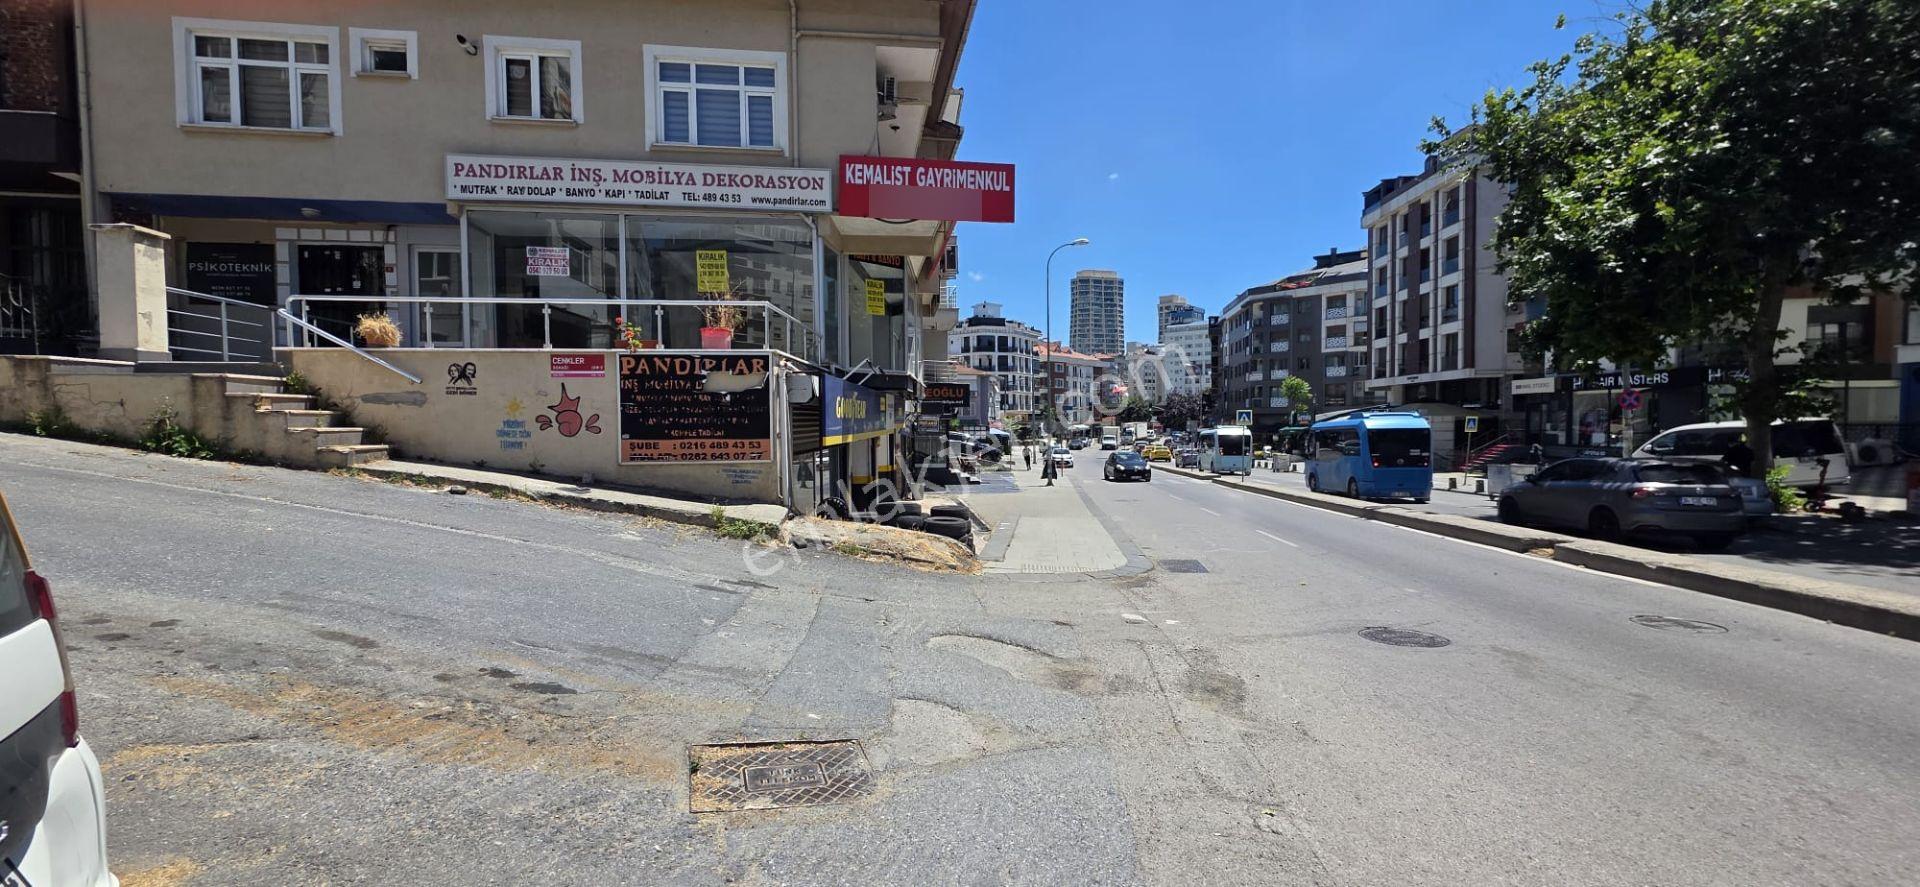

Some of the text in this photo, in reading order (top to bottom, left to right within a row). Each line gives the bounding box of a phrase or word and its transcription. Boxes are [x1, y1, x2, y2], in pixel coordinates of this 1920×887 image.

[454, 162, 825, 191] PANDIRLAR İNŞ. MOBİLYA DEKORASYON
[461, 185, 497, 195] MUTFAK
[527, 186, 556, 197] DOLAP
[566, 188, 595, 198] BANYO
[605, 189, 625, 199] KAPI
[635, 189, 669, 201] TADİLAT
[682, 192, 700, 202] TEL:
[702, 193, 716, 203] 489
[719, 193, 729, 203] 43
[732, 194, 741, 203] 53
[751, 196, 827, 207] www.pandirlar.com
[189, 261, 272, 273] PSİKOTEKNİK
[552, 357, 584, 365] CENKLER
[629, 441, 660, 451] ŞUBE
[680, 441, 706, 450] 0216
[709, 441, 729, 449] 489
[732, 441, 745, 449] 43
[748, 441, 761, 449] 53
[711, 452, 730, 461] 643
[734, 452, 746, 461] 07
